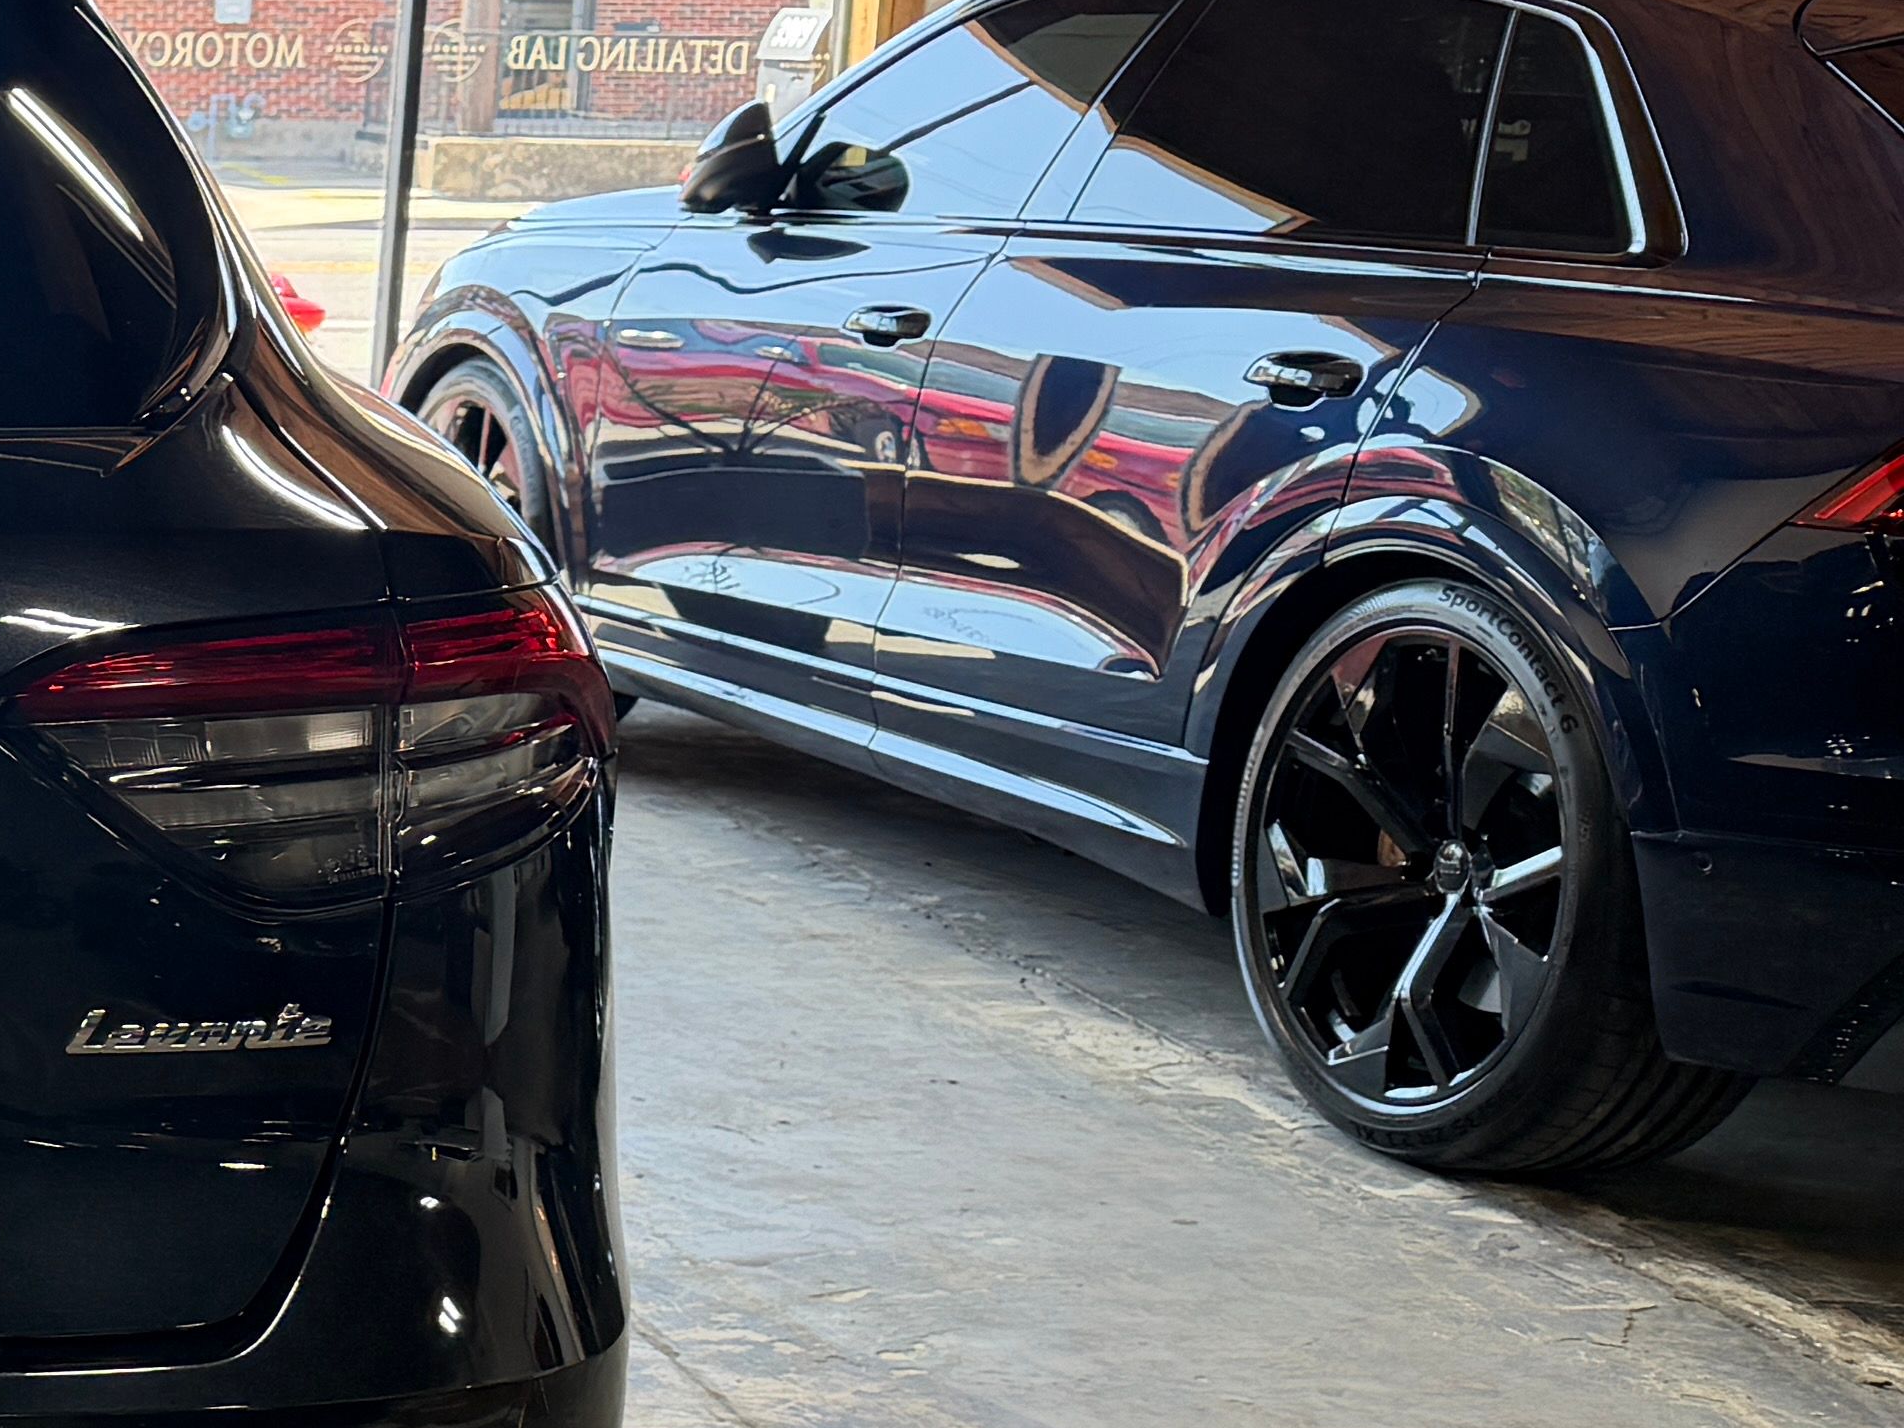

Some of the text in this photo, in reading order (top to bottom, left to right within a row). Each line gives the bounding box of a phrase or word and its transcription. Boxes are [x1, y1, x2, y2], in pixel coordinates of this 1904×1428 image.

[1438, 585, 1579, 734] SportContact 6
[66, 1003, 332, 1054] Levante
